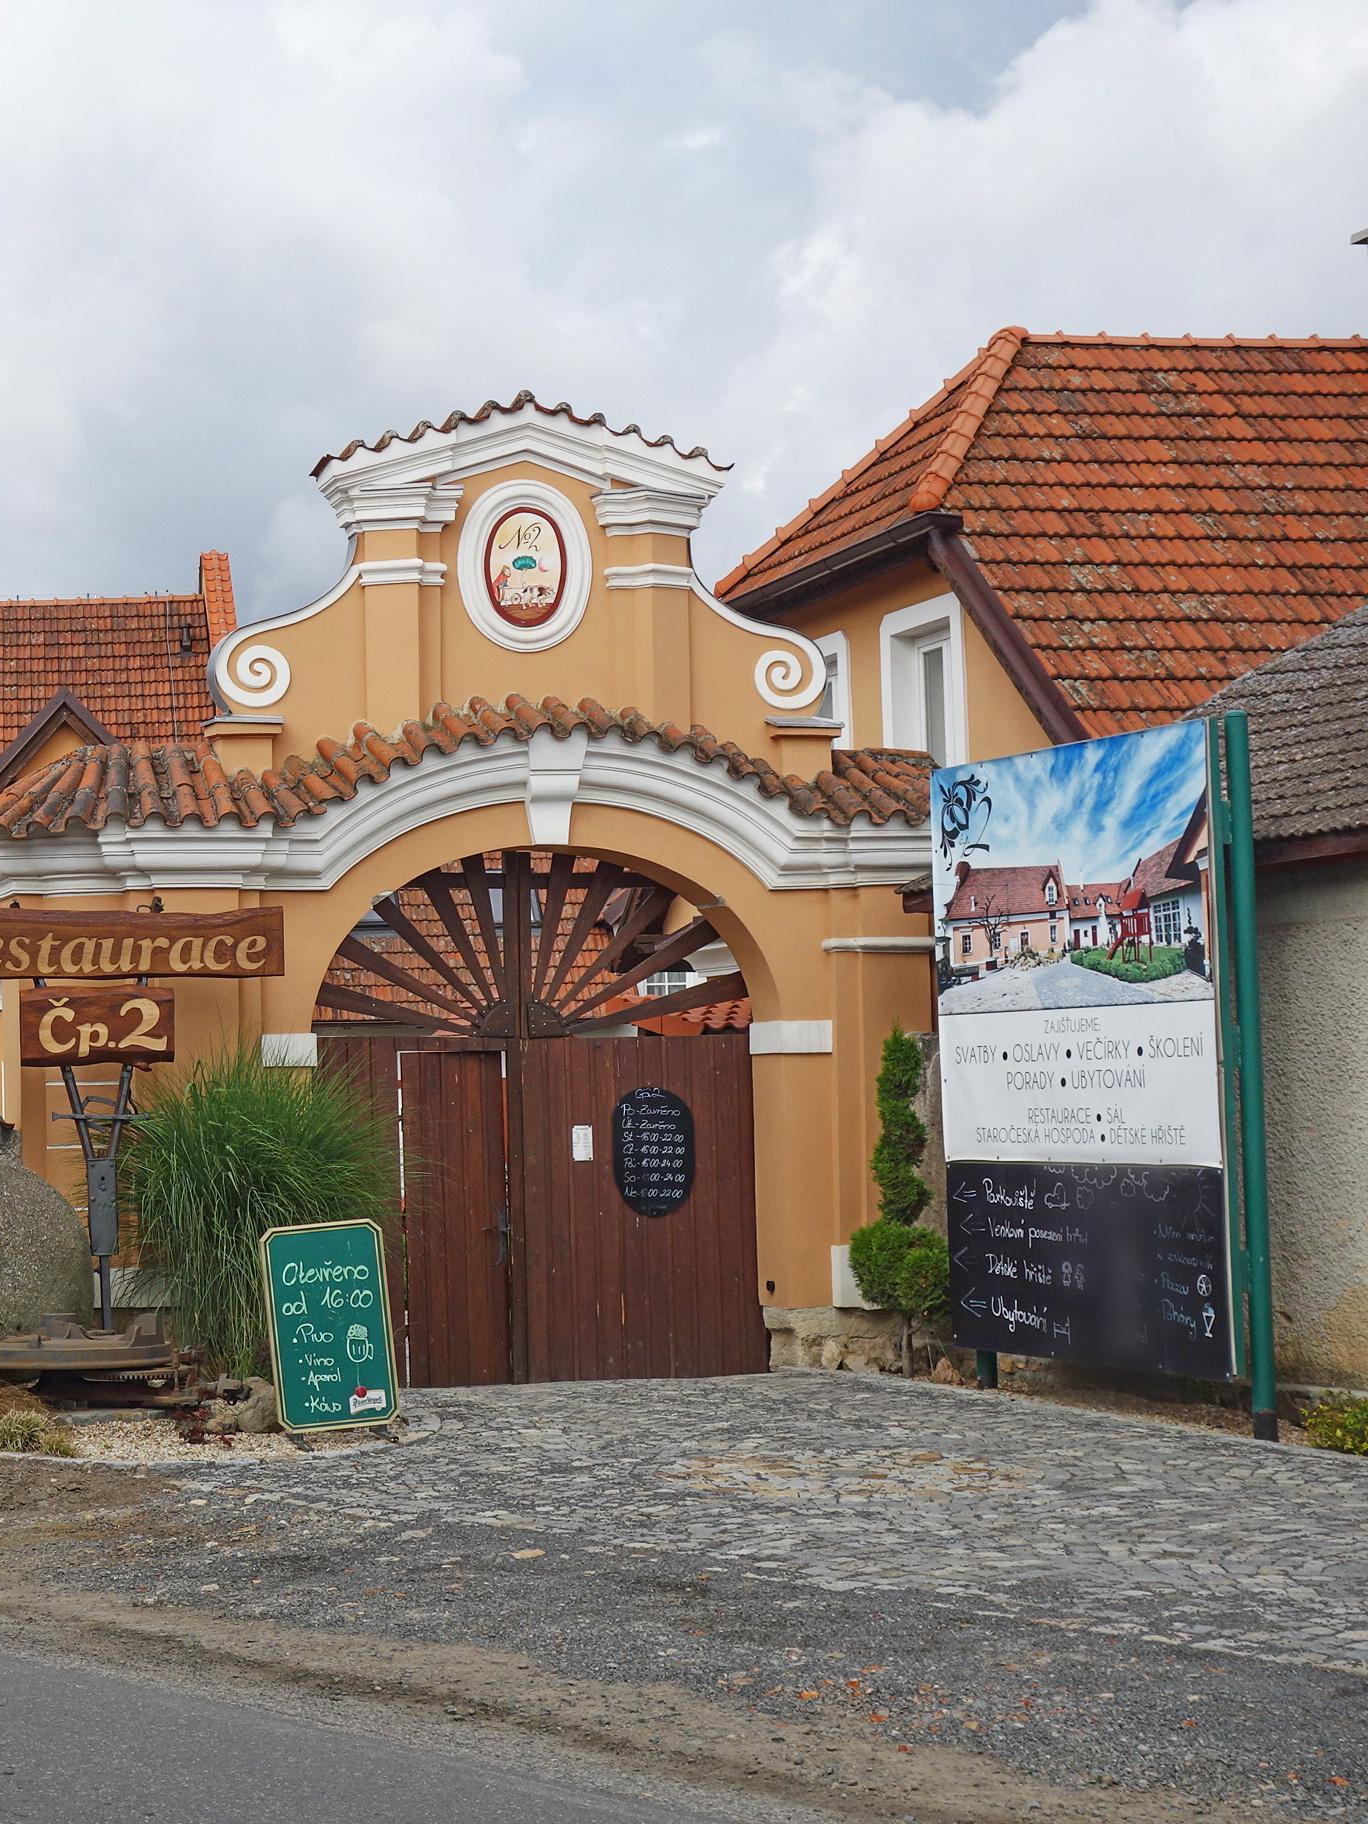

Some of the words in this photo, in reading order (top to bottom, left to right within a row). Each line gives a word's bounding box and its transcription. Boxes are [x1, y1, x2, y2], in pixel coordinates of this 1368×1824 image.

[39, 997, 168, 1058] Čp.2
[955, 1045, 997, 1064] SVATBY
[1012, 1043, 1060, 1062] OSLAVY
[1077, 1036, 1130, 1060] VEČÍRKY
[1148, 1031, 1204, 1058] ŠKOLENÍ
[1006, 1071, 1054, 1090] PORADY
[1071, 1063, 1146, 1089] UBYTOVÁNÍ
[1028, 1107, 1091, 1124] RESTAURACE
[1106, 1104, 1126, 1124] SÁL
[976, 1124, 1040, 1143] STAROČESKÁ
[1044, 1127, 1096, 1144] HOSPODA
[1110, 1124, 1147, 1144] DĚTSKÉ
[1151, 1125, 1186, 1145] HŘIŠTĚ
[282, 1260, 369, 1286] Otevřeno
[282, 1291, 307, 1316] od
[320, 1287, 374, 1309] 16:00
[296, 1323, 334, 1344] Pivo
[310, 1395, 342, 1413] Káva
